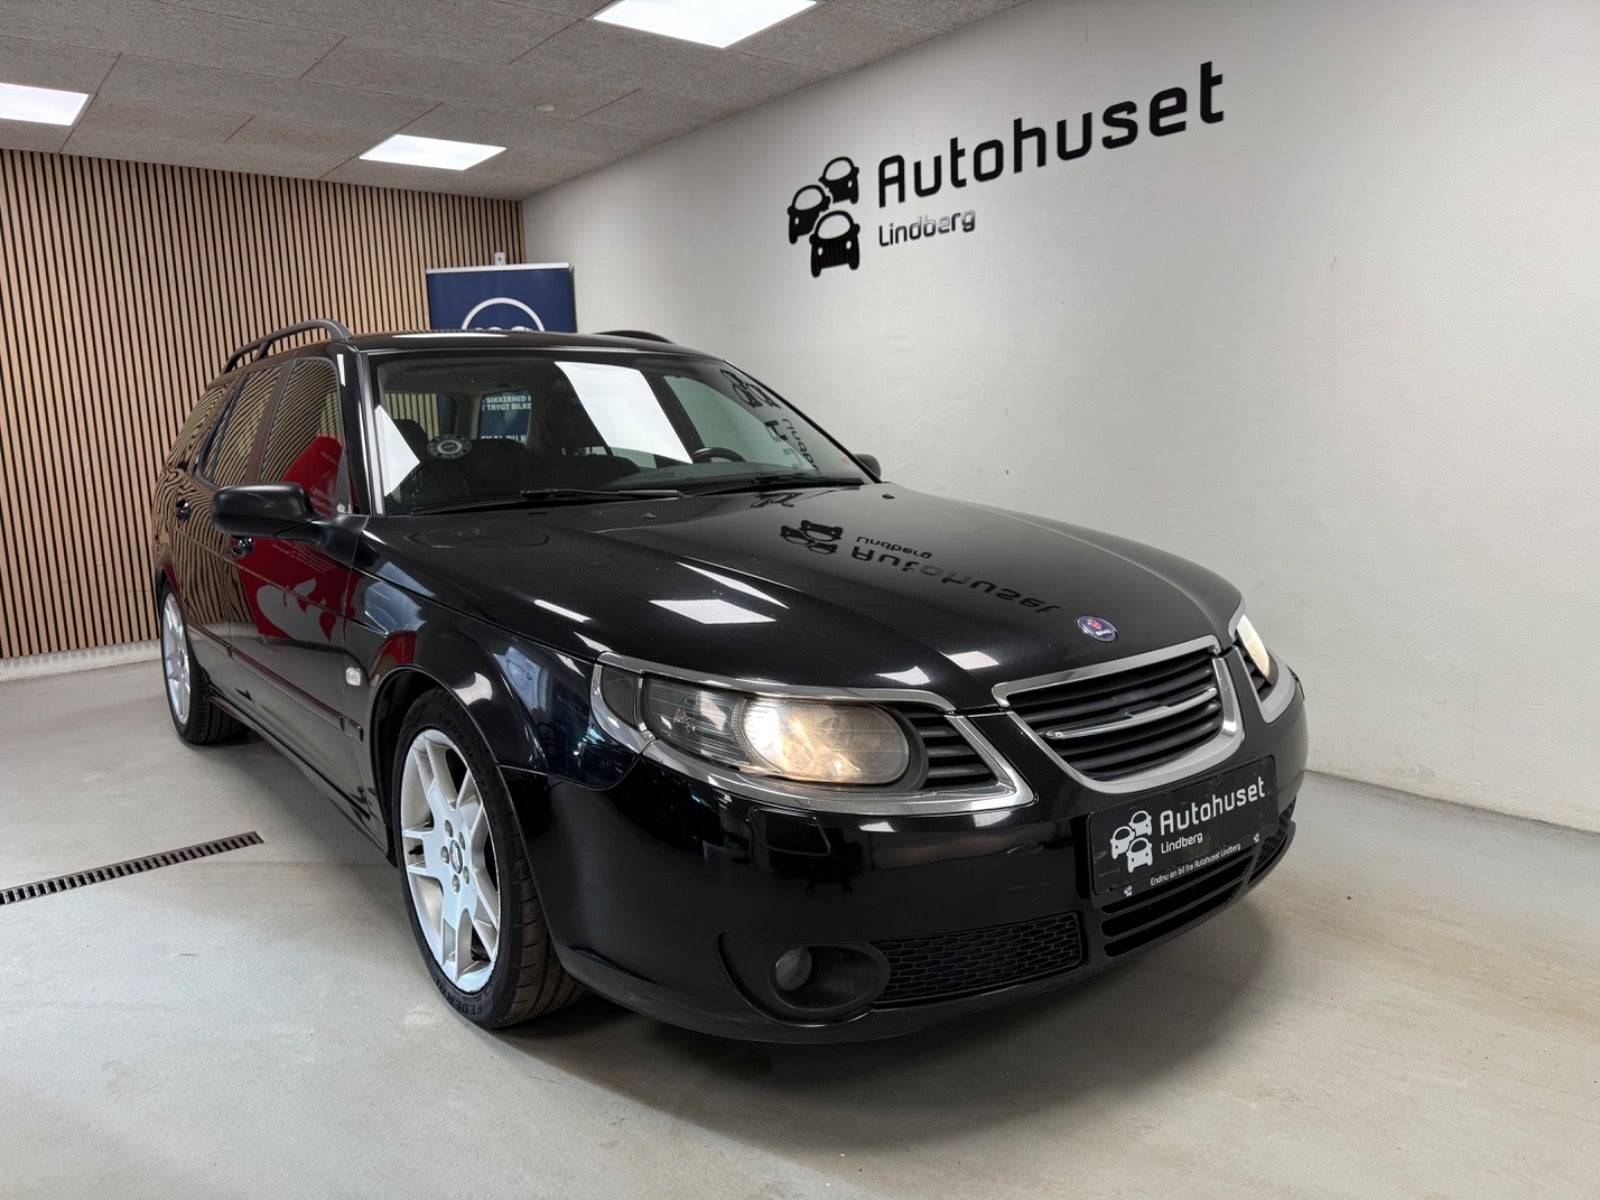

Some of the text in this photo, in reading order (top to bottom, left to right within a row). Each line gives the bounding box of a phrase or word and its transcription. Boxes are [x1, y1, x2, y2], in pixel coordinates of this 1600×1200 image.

[878, 60, 1224, 208] Autohuset
[878, 209, 976, 247] Lindberg
[1159, 776, 1266, 836] Autohuset
[1150, 873, 1169, 886] Endnu
[1170, 870, 1177, 878] en
[1185, 863, 1194, 872] fra
[1193, 851, 1220, 868] Autohuset
[1220, 843, 1241, 858] Lindberg
[1161, 832, 1203, 854] Lindberg
